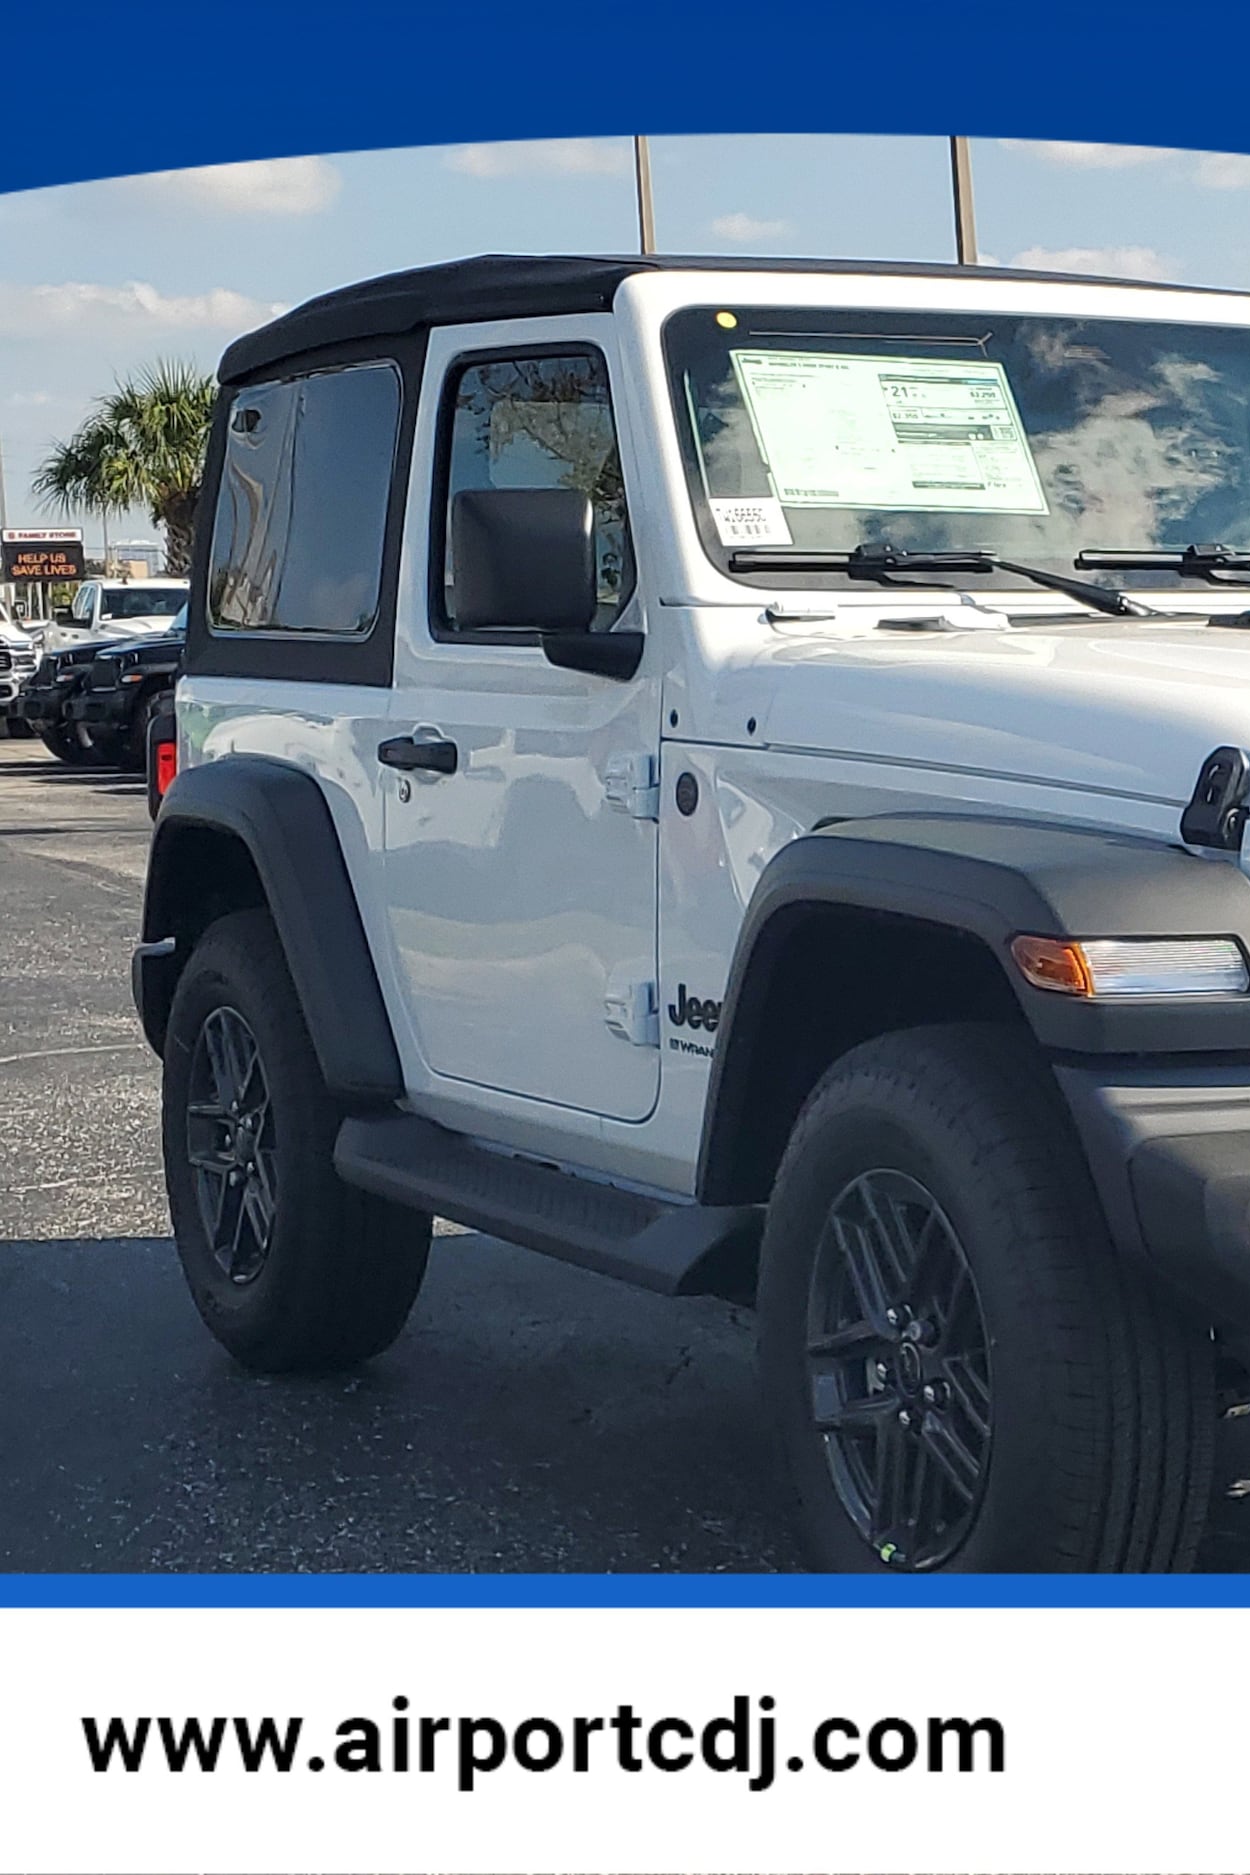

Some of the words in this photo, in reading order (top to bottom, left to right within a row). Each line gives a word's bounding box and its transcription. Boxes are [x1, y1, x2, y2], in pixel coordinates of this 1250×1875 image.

[18, 552, 48, 563] HELP
[49, 552, 66, 563] US
[11, 565, 42, 576] SAVE
[44, 564, 77, 576] LIVES
[668, 983, 723, 1032] Jee
[680, 1040, 714, 1058] WRAN
